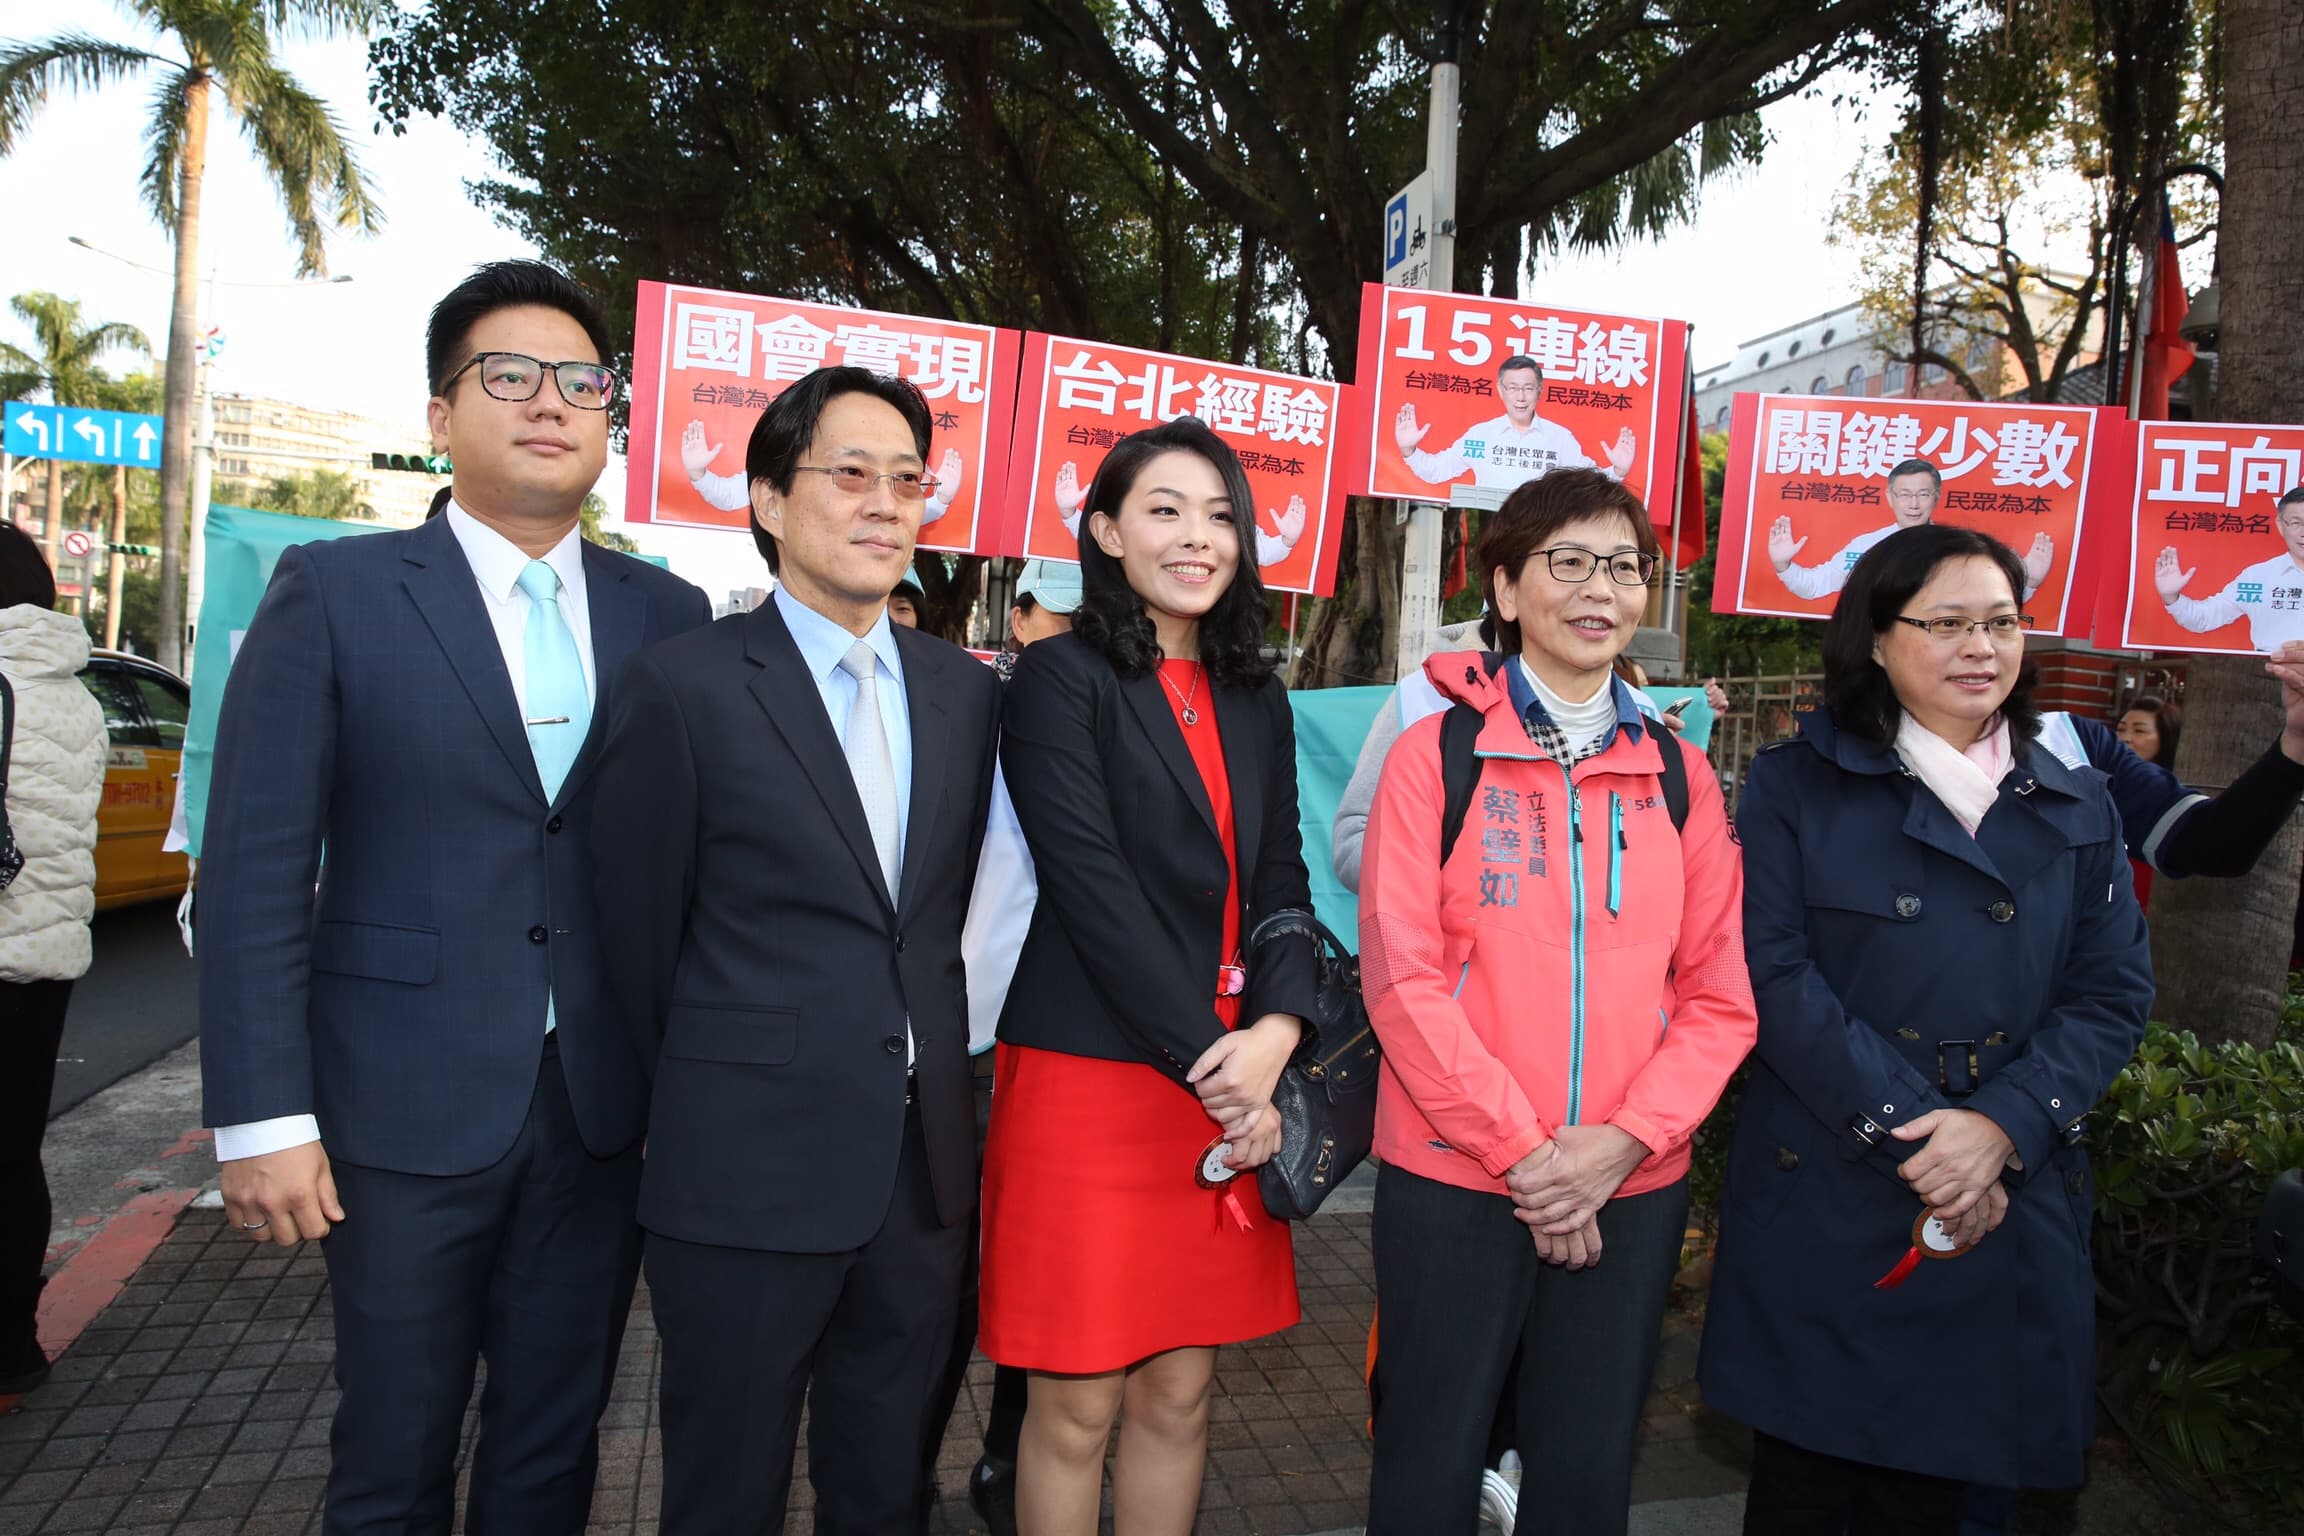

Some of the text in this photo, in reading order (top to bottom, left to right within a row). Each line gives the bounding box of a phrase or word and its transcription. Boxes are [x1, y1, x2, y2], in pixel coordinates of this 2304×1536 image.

[1389, 208, 1403, 259] P
[672, 302, 984, 403] 國會實現
[691, 382, 778, 410] 台灣為
[1053, 351, 1329, 447] 台北經驗
[1405, 371, 1633, 411] 台灣為名 民眾為本
[1231, 449, 1304, 476] 眾為本
[1492, 444, 1558, 460] 台灣民眾黨
[1764, 408, 2079, 489] 關鍵少數
[2147, 436, 2304, 508] 正向
[1780, 481, 2052, 515] 台灣為名 民眾為本
[2165, 511, 2270, 534] 台灣為名
[2271, 600, 2304, 611] 志工
[1527, 791, 1547, 878] 立法委員
